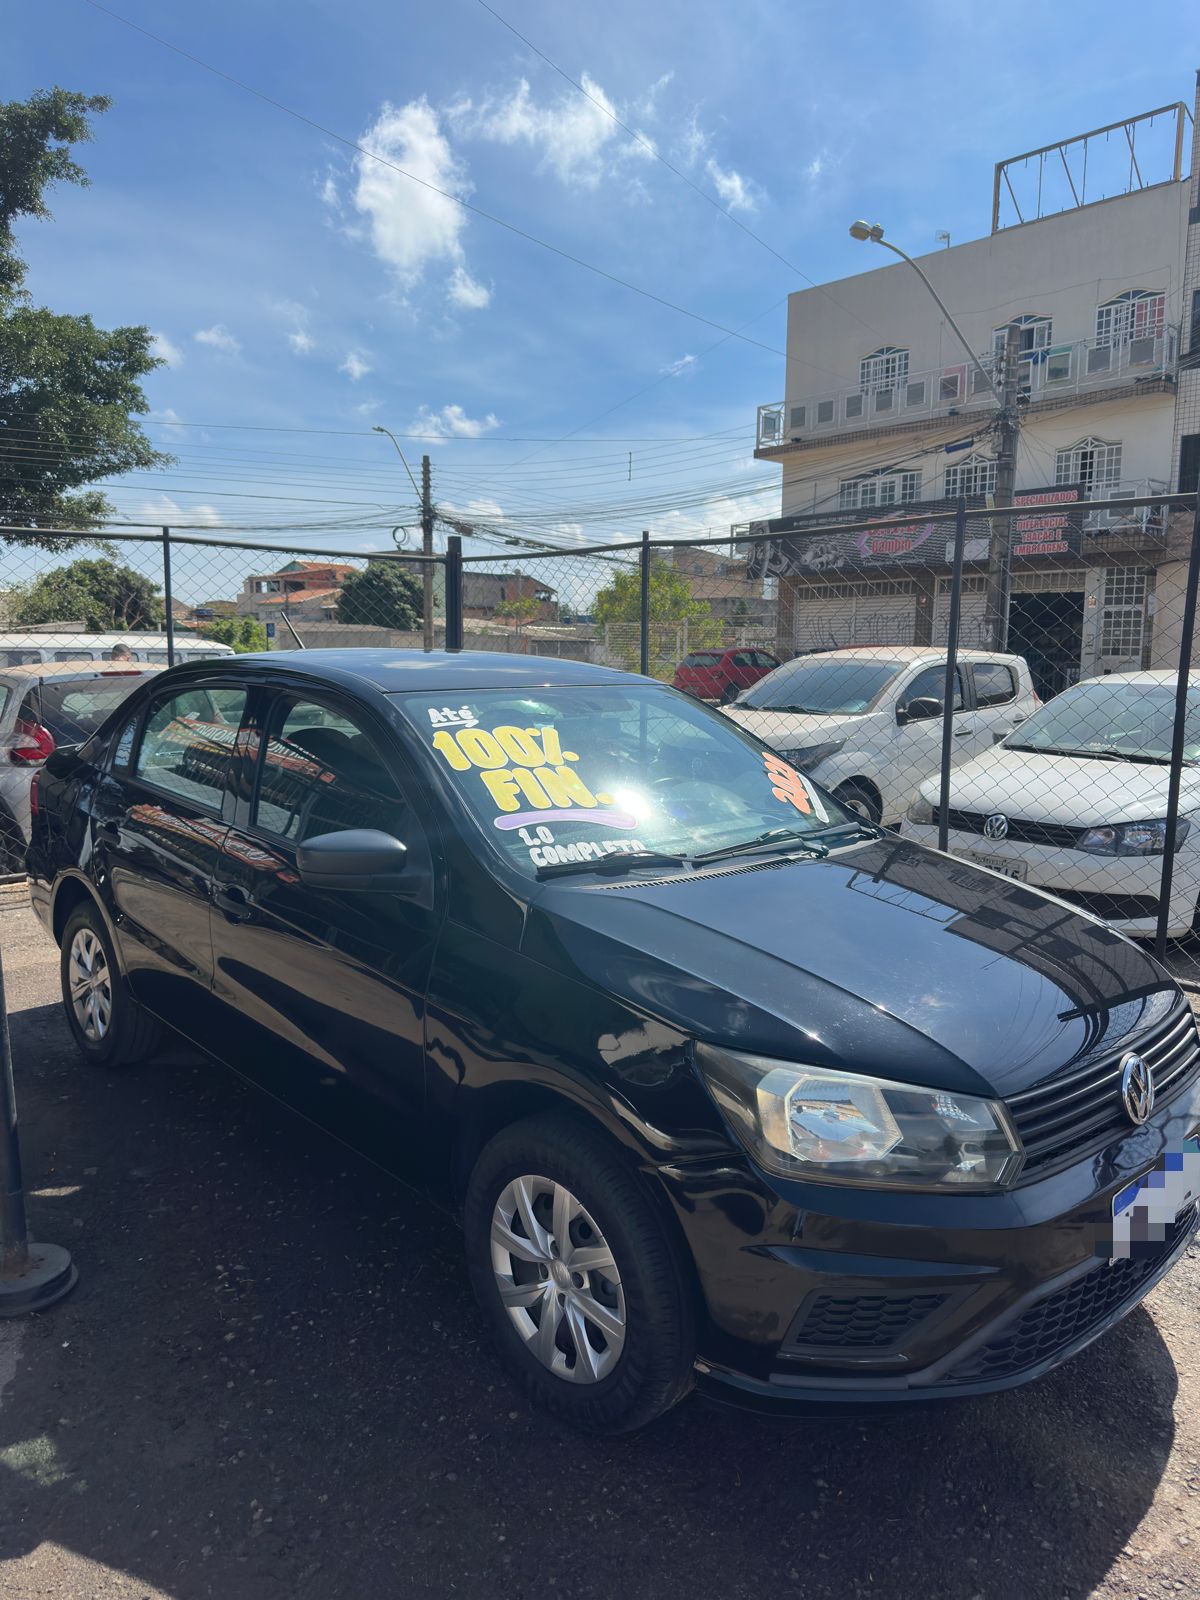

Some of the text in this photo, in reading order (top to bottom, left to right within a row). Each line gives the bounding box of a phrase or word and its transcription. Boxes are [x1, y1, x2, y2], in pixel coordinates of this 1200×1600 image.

[428, 706, 474, 722] Até
[432, 725, 580, 771] 100%
[518, 826, 555, 846] 1.0
